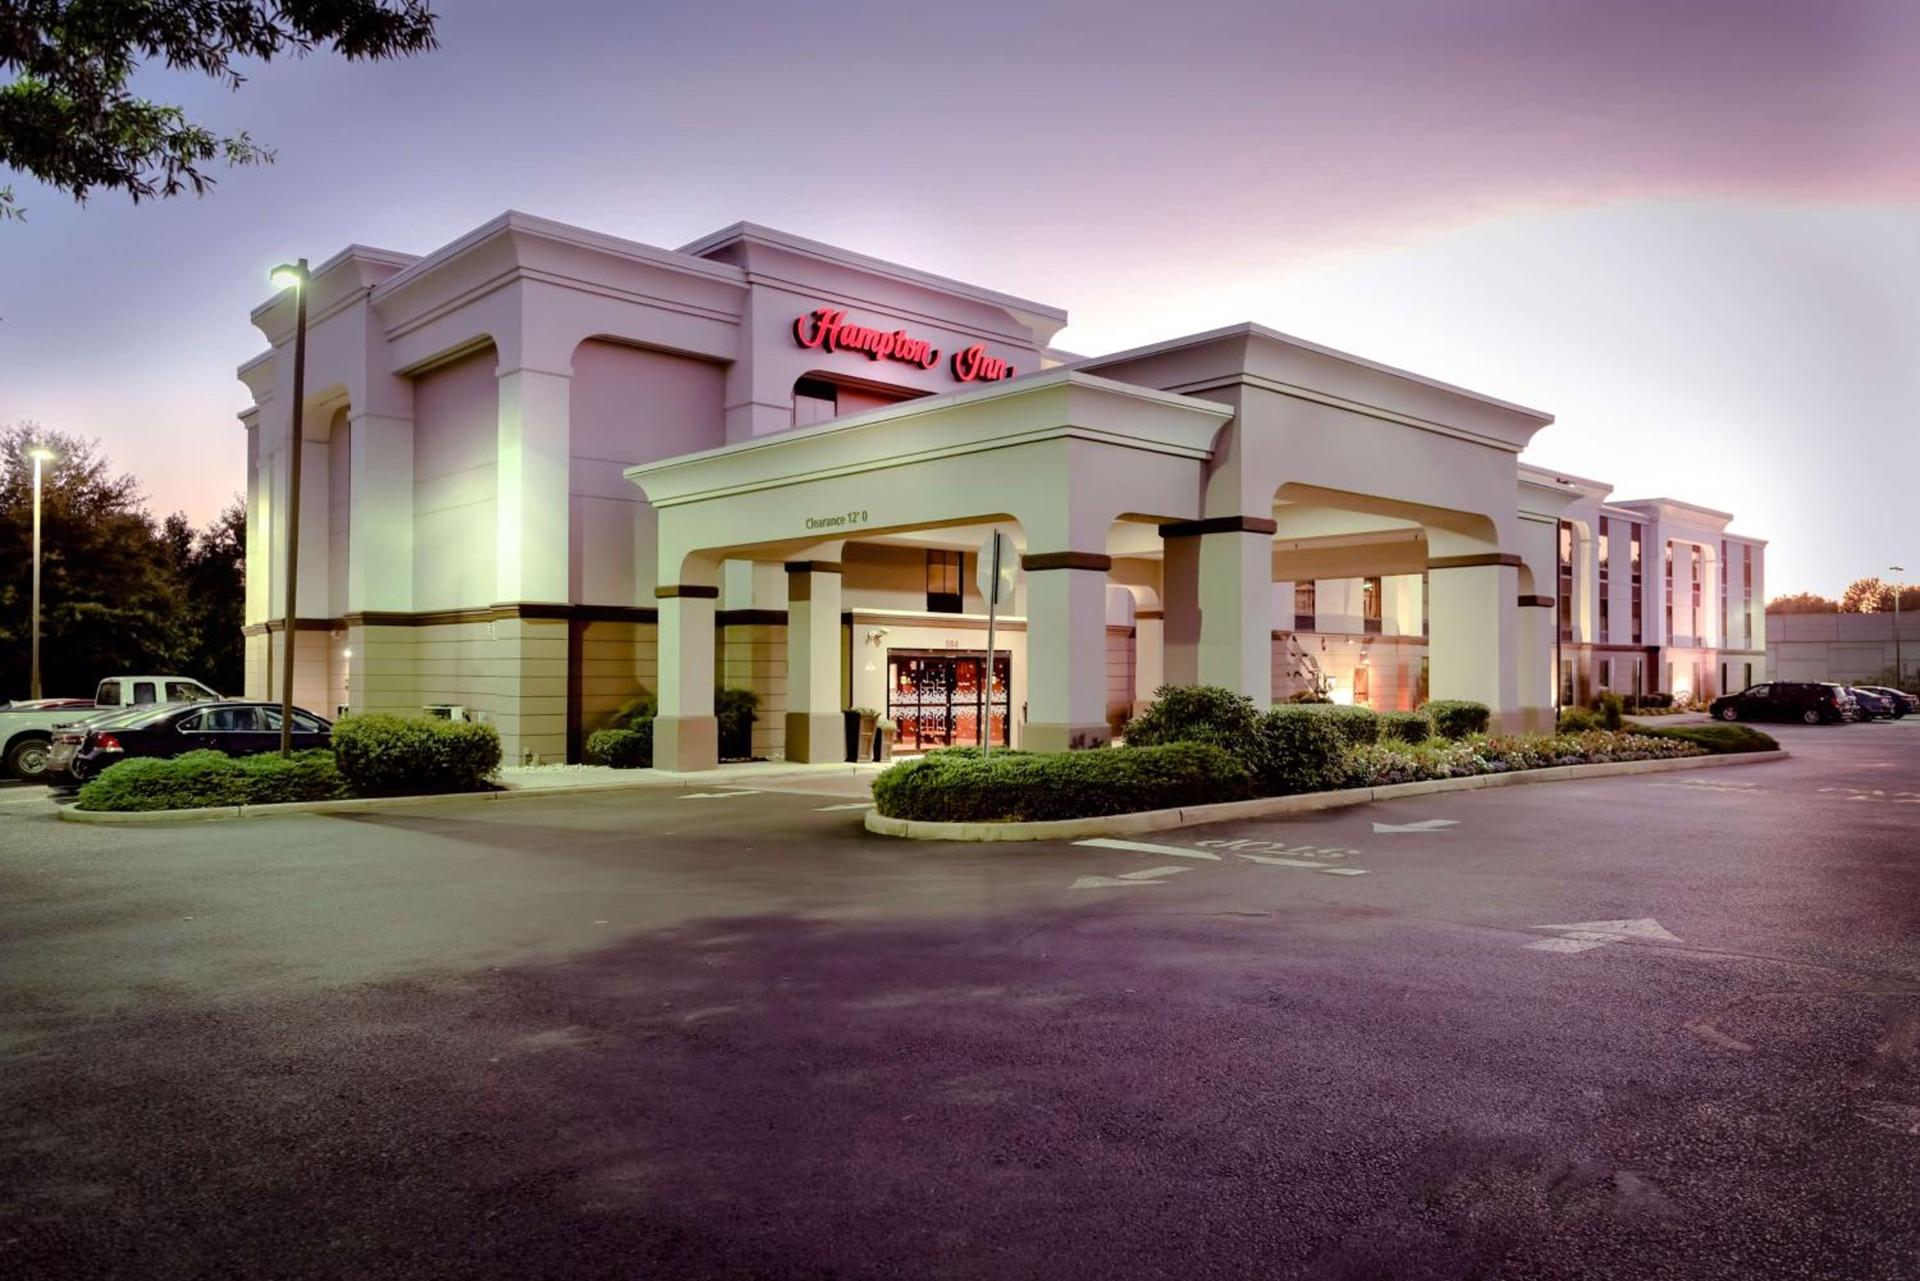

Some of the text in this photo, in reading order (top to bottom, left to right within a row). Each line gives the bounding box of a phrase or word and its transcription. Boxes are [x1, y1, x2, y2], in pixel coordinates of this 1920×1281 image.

[793, 307, 1017, 382] Hampton Inn
[805, 517, 846, 530] Clearance
